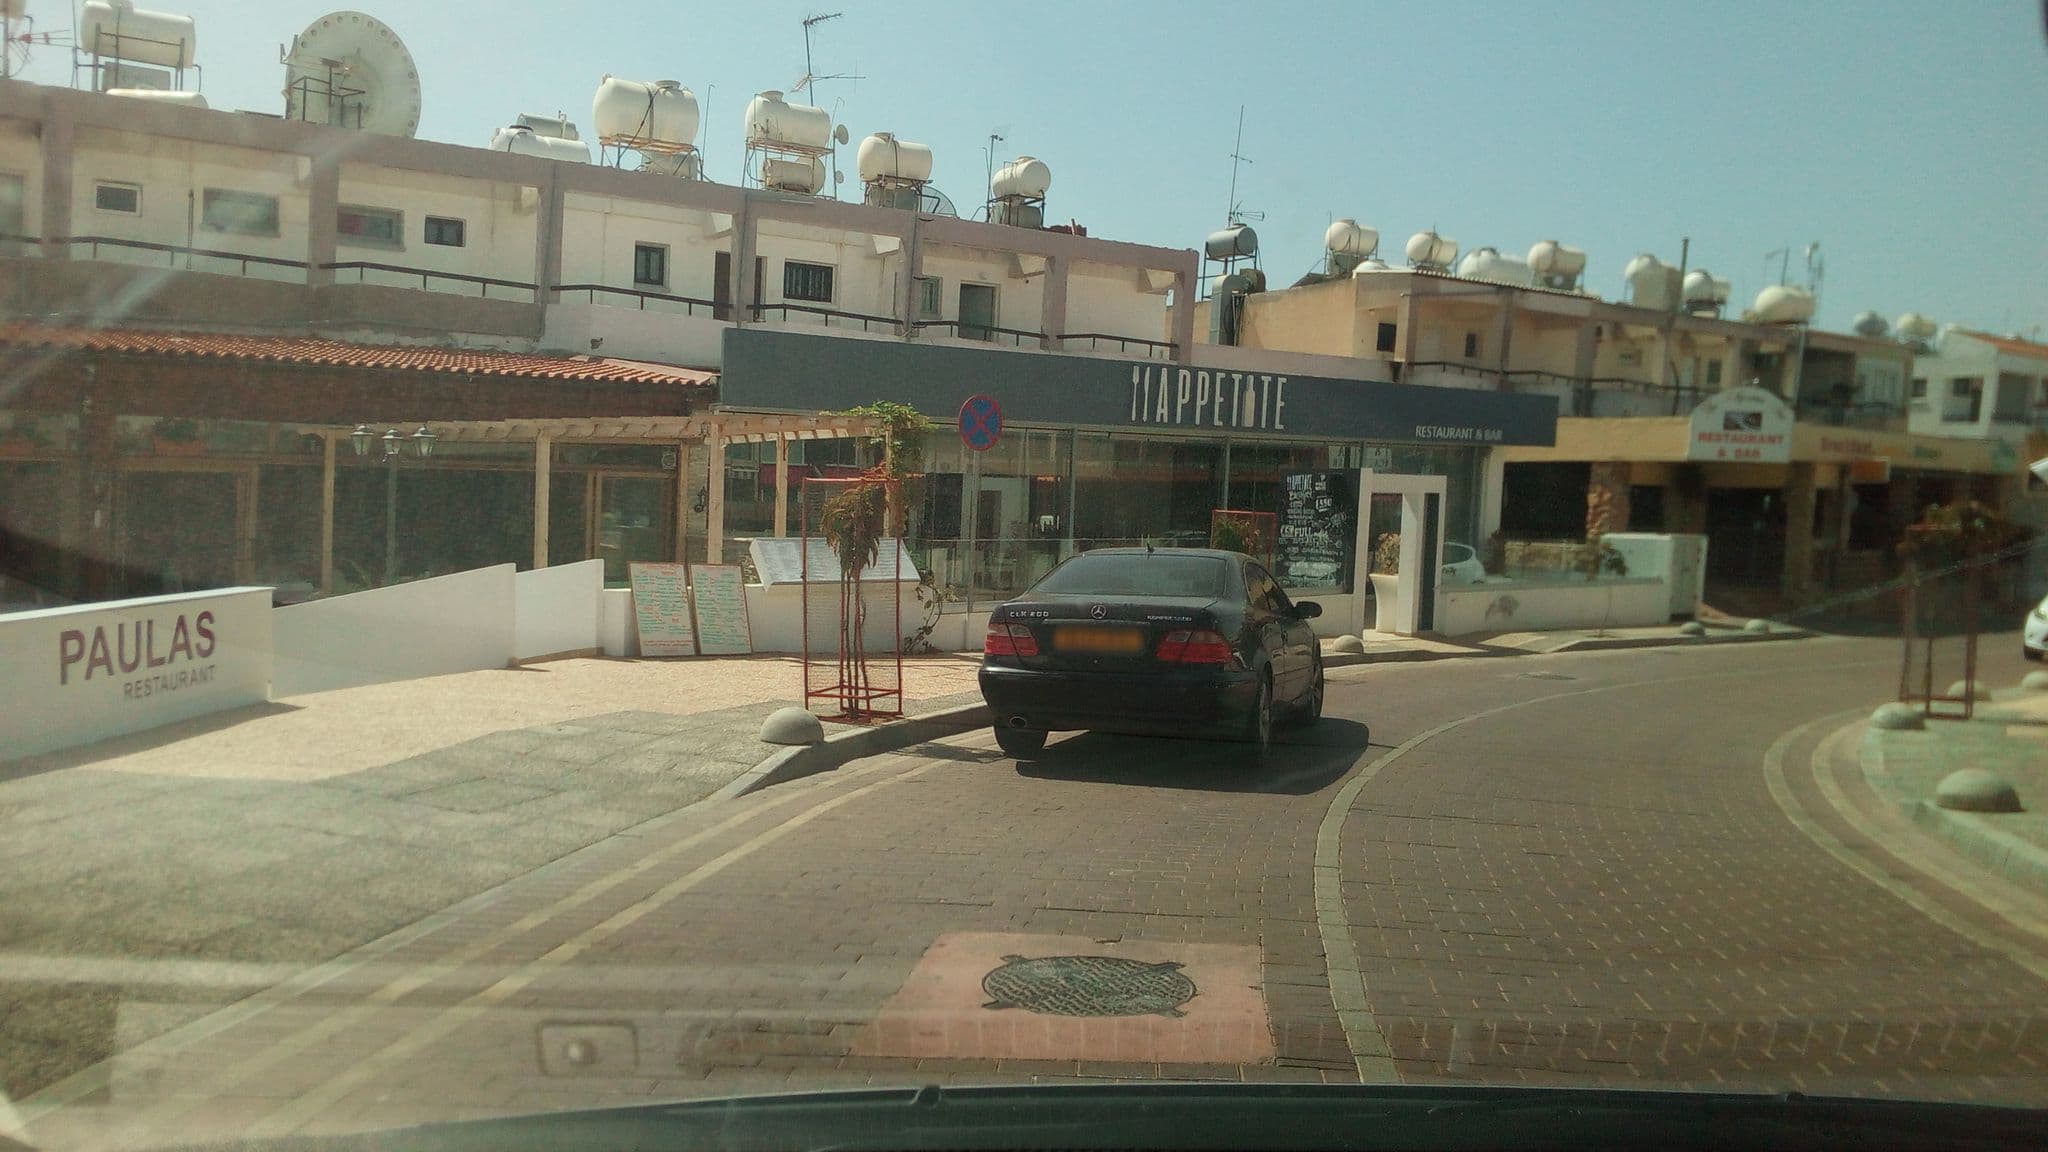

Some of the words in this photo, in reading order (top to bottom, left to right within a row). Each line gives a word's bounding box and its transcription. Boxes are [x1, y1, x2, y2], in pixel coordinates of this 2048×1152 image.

[1415, 425, 1474, 440] RESTAURANT
[1697, 431, 1784, 445] RESTAURANT
[60, 610, 216, 685] PAULAS
[123, 664, 216, 698] RESTAURANT
